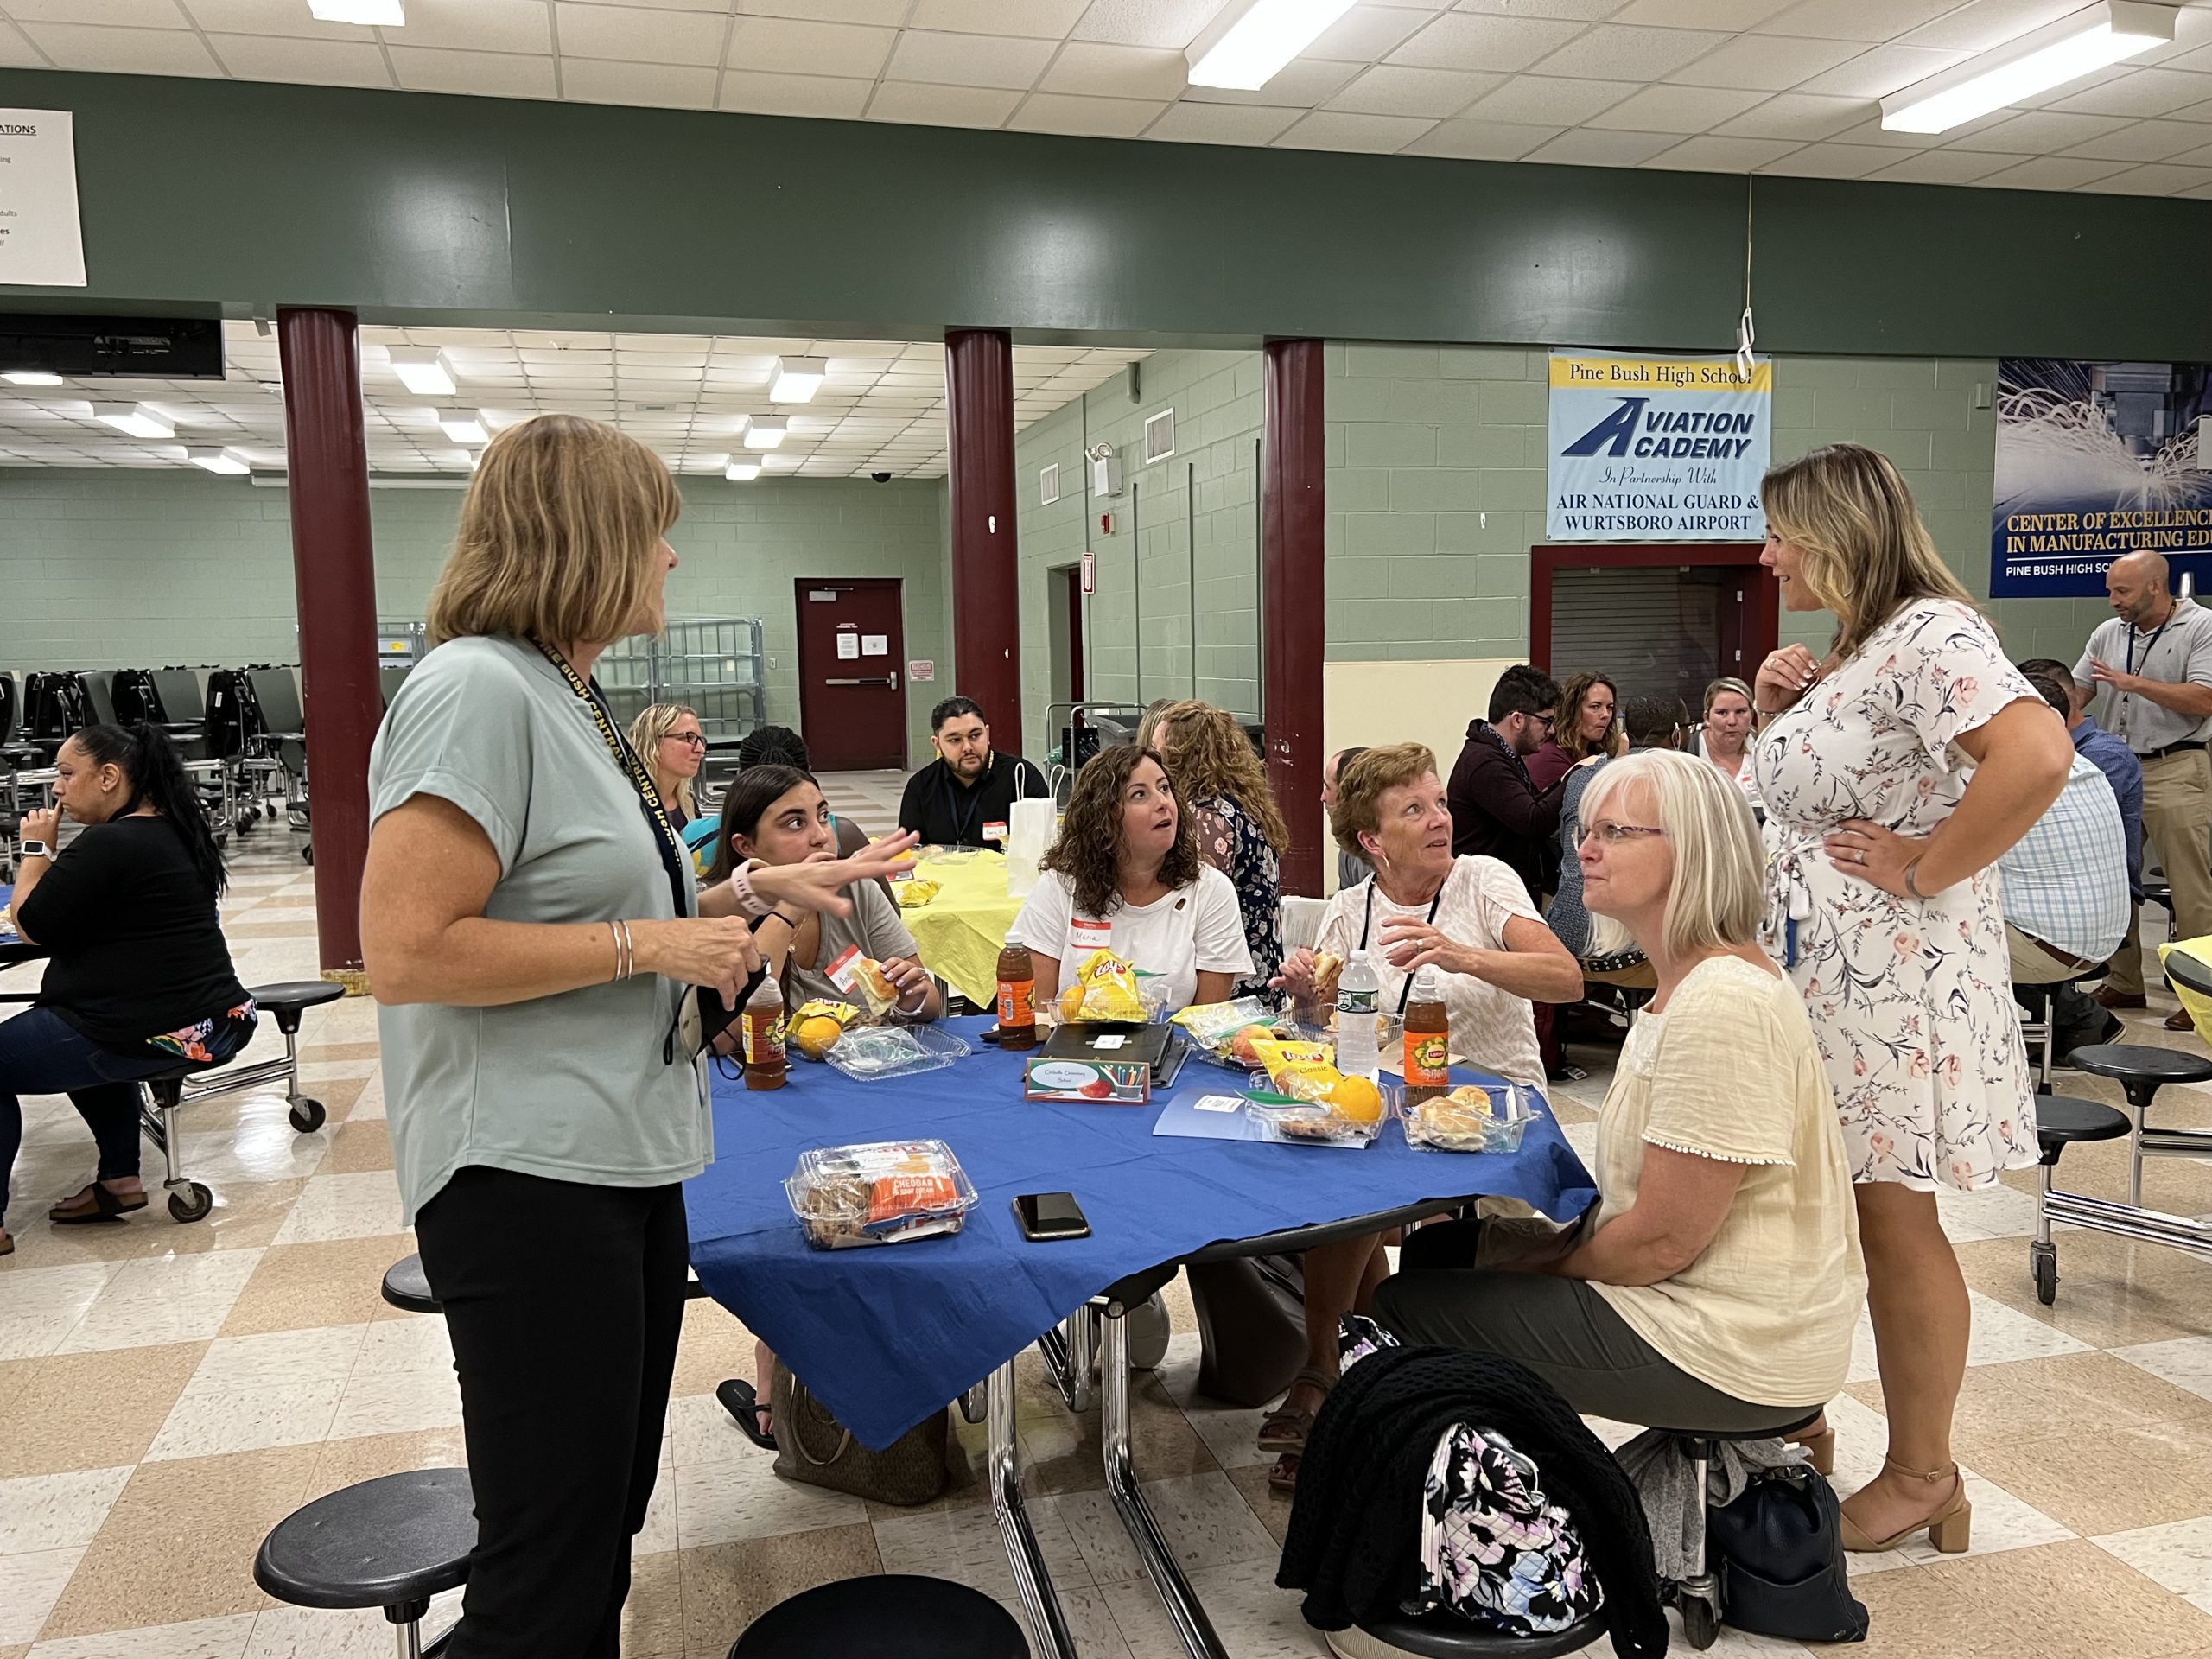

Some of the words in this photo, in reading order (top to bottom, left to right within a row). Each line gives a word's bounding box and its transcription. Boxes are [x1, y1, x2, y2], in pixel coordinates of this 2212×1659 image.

[1569, 364, 1605, 380] Pine
[1611, 365, 1649, 382] Bush
[1656, 366, 1695, 388] High
[1700, 367, 1752, 385] School
[1599, 466, 1616, 484] In
[1618, 466, 1682, 488] Partnership
[1688, 467, 1718, 484] With
[1556, 494, 1587, 509] AIR
[1592, 494, 1679, 509] NATIONAL
[1683, 494, 1742, 509] GUARD
[1746, 495, 1759, 509] &
[1564, 515, 1674, 530] WURTSBORO
[1677, 515, 1751, 530] AIRPORT
[2007, 513, 2080, 532] CENTER
[2082, 512, 2107, 530] OF
[2006, 536, 2026, 553] IN
[2030, 531, 2183, 552] MANUFACTURING
[2005, 566, 2031, 577] PINE
[2033, 564, 2063, 575] BUSH
[2066, 563, 2093, 574] HIGH
[2095, 563, 2112, 573] SC
[560, 664, 591, 699] BUSH
[588, 702, 624, 761] CENTRAL
[627, 748, 659, 808] CENTRAL
[893, 1179, 934, 1188] CHEDDAR
